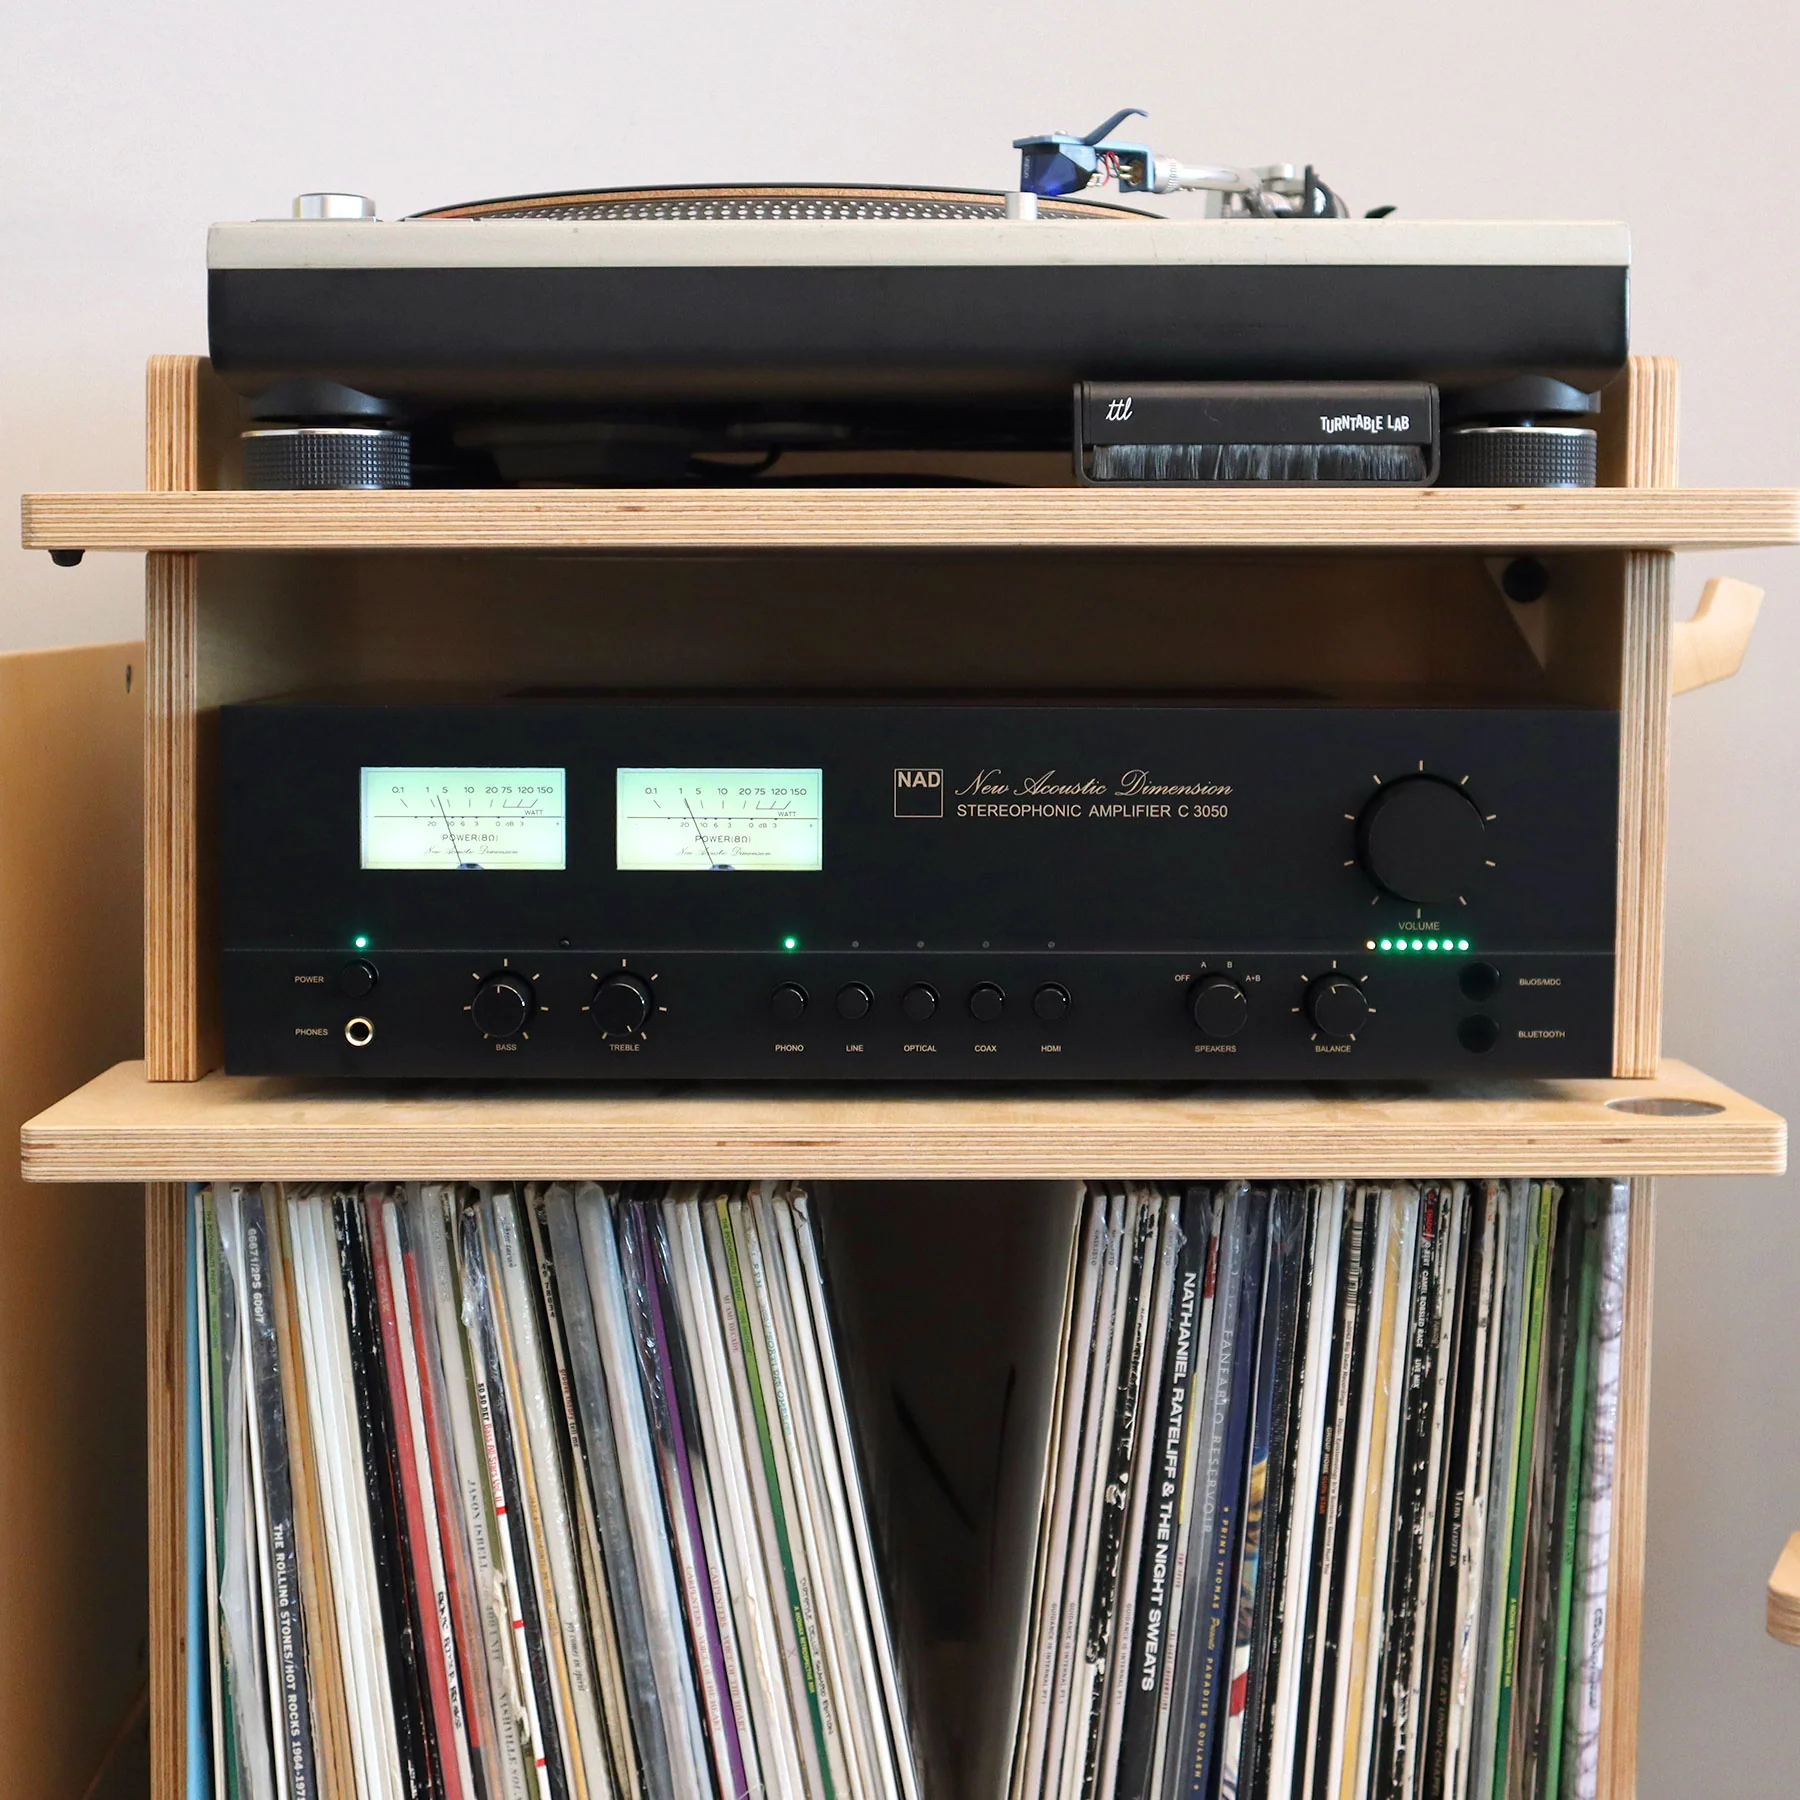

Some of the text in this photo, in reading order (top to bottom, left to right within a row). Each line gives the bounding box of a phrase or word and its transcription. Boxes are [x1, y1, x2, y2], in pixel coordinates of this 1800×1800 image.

[1105, 397, 1134, 421] ttl
[1320, 414, 1410, 434] TURNTABLE LAB
[897, 771, 941, 788] NAD
[955, 769, 1234, 796] New Acoustic Dimension
[391, 786, 405, 794] 0.1
[442, 786, 448, 794] 5
[464, 786, 475, 794] 10
[485, 786, 499, 794] 20
[501, 786, 513, 794] 75
[517, 786, 534, 794] 120
[537, 786, 553, 794] 150
[957, 804, 1228, 818] STEREOPHONIC AMPLIFIER C 3050
[1398, 922, 1440, 931] VOLUME
[1200, 961, 1207, 969] A
[1226, 961, 1233, 969] B
[295, 975, 324, 984] POWER
[1174, 974, 1190, 982] OFF
[1245, 974, 1261, 982] A+B
[295, 1028, 328, 1037] PHONES
[1518, 1030, 1566, 1039] BLUETOOTH
[495, 1043, 517, 1052] BASS
[609, 1043, 640, 1052] TREBLE
[774, 1044, 804, 1052] PHONO
[846, 1044, 864, 1052] LINE
[903, 1044, 937, 1053] OPTICAL
[974, 1044, 997, 1053] COAX
[1041, 1044, 1062, 1053] HDMI
[1194, 1045, 1237, 1054] SPEAKERS
[1315, 1045, 1352, 1053] BALANCE
[1420, 1270, 1430, 1294] CAMEL
[1417, 1296, 1427, 1327] BOBSLED
[727, 1323, 739, 1353] DECADE
[1415, 1328, 1425, 1348] RACE
[1414, 1358, 1422, 1372] LIVE
[477, 1383, 486, 1393] SO
[1339, 1371, 1349, 1406] Recordings
[1412, 1374, 1421, 1388] MIX
[479, 1395, 488, 1405] SO
[484, 1423, 493, 1443] Bass
[569, 1422, 577, 1434] tell
[572, 1436, 580, 1448] me
[1325, 1427, 1333, 1452] GROUP
[1323, 1453, 1331, 1474] HOME
[1142, 1272, 1197, 1691] NATHANIEL RATELIFF & THE NIGHT SWEATS
[1202, 1435, 1222, 1534] RESERVOIR
[273, 1523, 285, 1548] THE
[1218, 1519, 1229, 1554] PRINS
[275, 1553, 289, 1607] ROLLING
[1212, 1561, 1224, 1609] THOMAS
[468, 1480, 479, 1520] JASON
[474, 1524, 487, 1572] ISBELL
[499, 1692, 517, 1765] NASHVILLE
[1048, 1603, 1058, 1640] GUIDANCE
[1065, 1602, 1076, 1640] GUIDANCE
[1123, 1603, 1133, 1640] GUIDANCE
[280, 1611, 296, 1690] STONES/HOT
[686, 1566, 721, 1731] CARPENTERS VOICE OF THE HEART
[710, 1566, 746, 1733] CARPENTERS VOICE OF THE HEART
[1046, 1642, 1053, 1650] IS
[1042, 1652, 1052, 1687] INTERNAL
[1060, 1652, 1070, 1687] INTERNAL
[1117, 1652, 1127, 1688] INTERNAL
[1200, 1657, 1214, 1717] PARADISE
[288, 1694, 301, 1737] ROCKS
[1194, 1722, 1207, 1778] GOULASH
